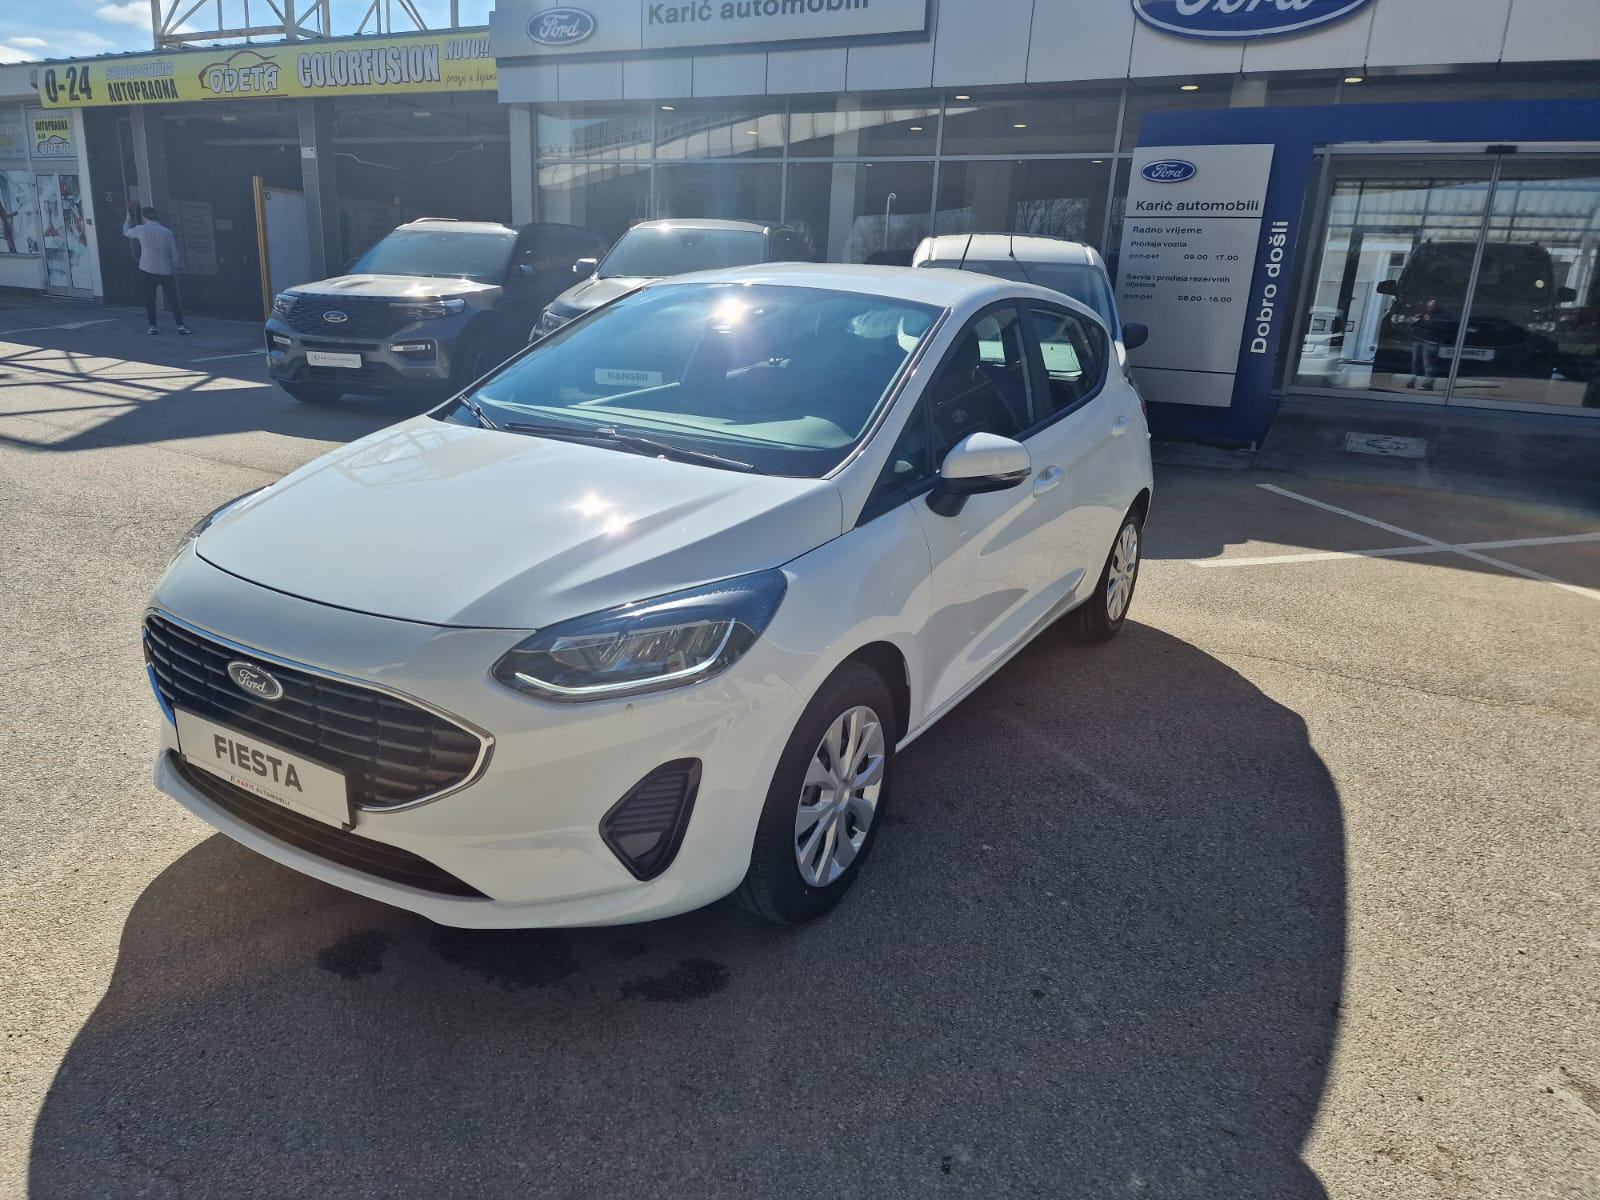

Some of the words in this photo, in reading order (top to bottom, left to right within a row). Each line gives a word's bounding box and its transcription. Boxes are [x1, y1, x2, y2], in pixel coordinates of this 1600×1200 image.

[649, 1, 713, 25] Karić
[540, 14, 580, 38] Ford
[297, 44, 441, 88] COLORFUSION
[45, 65, 93, 103] 0-24
[107, 78, 180, 103] AUTOPRAONA
[208, 65, 279, 94] ODETA
[1152, 163, 1184, 178] Ford
[1136, 200, 1173, 211] Karić
[1176, 200, 1259, 211] automobili
[1132, 226, 1163, 234] Radno
[1165, 226, 1203, 235] vrijeme
[1130, 240, 1161, 248] Prodaja
[1163, 240, 1188, 248] vozila
[1156, 274, 1188, 283] prodaja
[1189, 275, 1230, 283] rezervnih
[1250, 283, 1277, 354] Dobro
[1265, 221, 1289, 278] došli
[607, 371, 649, 382] RANGER
[238, 669, 267, 693] Ford
[213, 733, 303, 793] FIESTA
